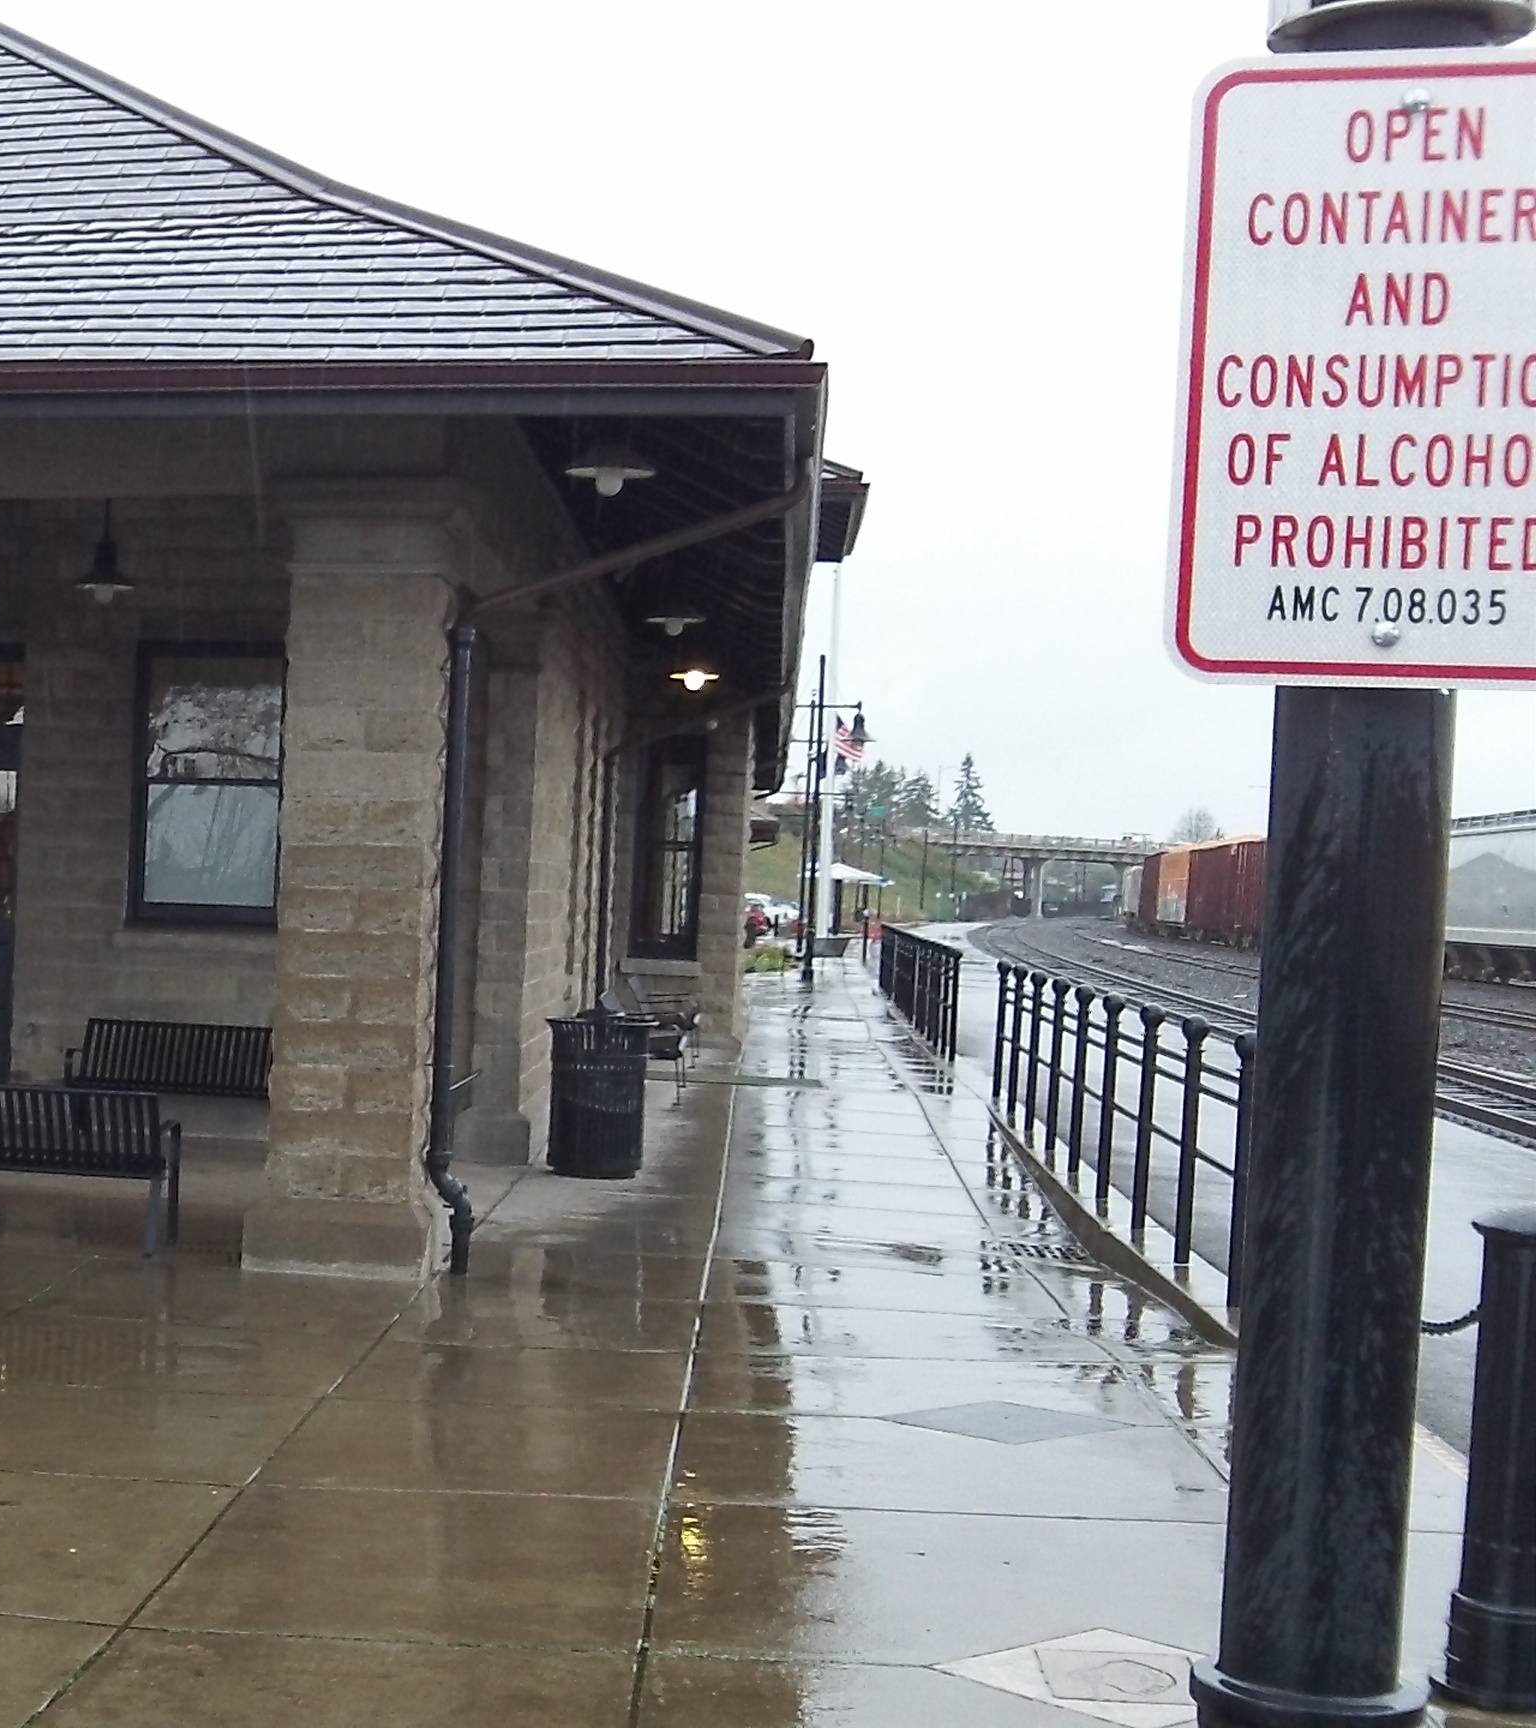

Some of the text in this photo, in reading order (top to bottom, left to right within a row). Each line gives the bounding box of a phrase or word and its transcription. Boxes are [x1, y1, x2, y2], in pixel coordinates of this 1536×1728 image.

[1345, 107, 1486, 163] OPEN
[1247, 189, 1536, 246] CONTAINER
[1345, 272, 1452, 327] AND
[1227, 432, 1533, 488] OF ALCOHO
[1266, 585, 1508, 626] AMC 7.08.035
